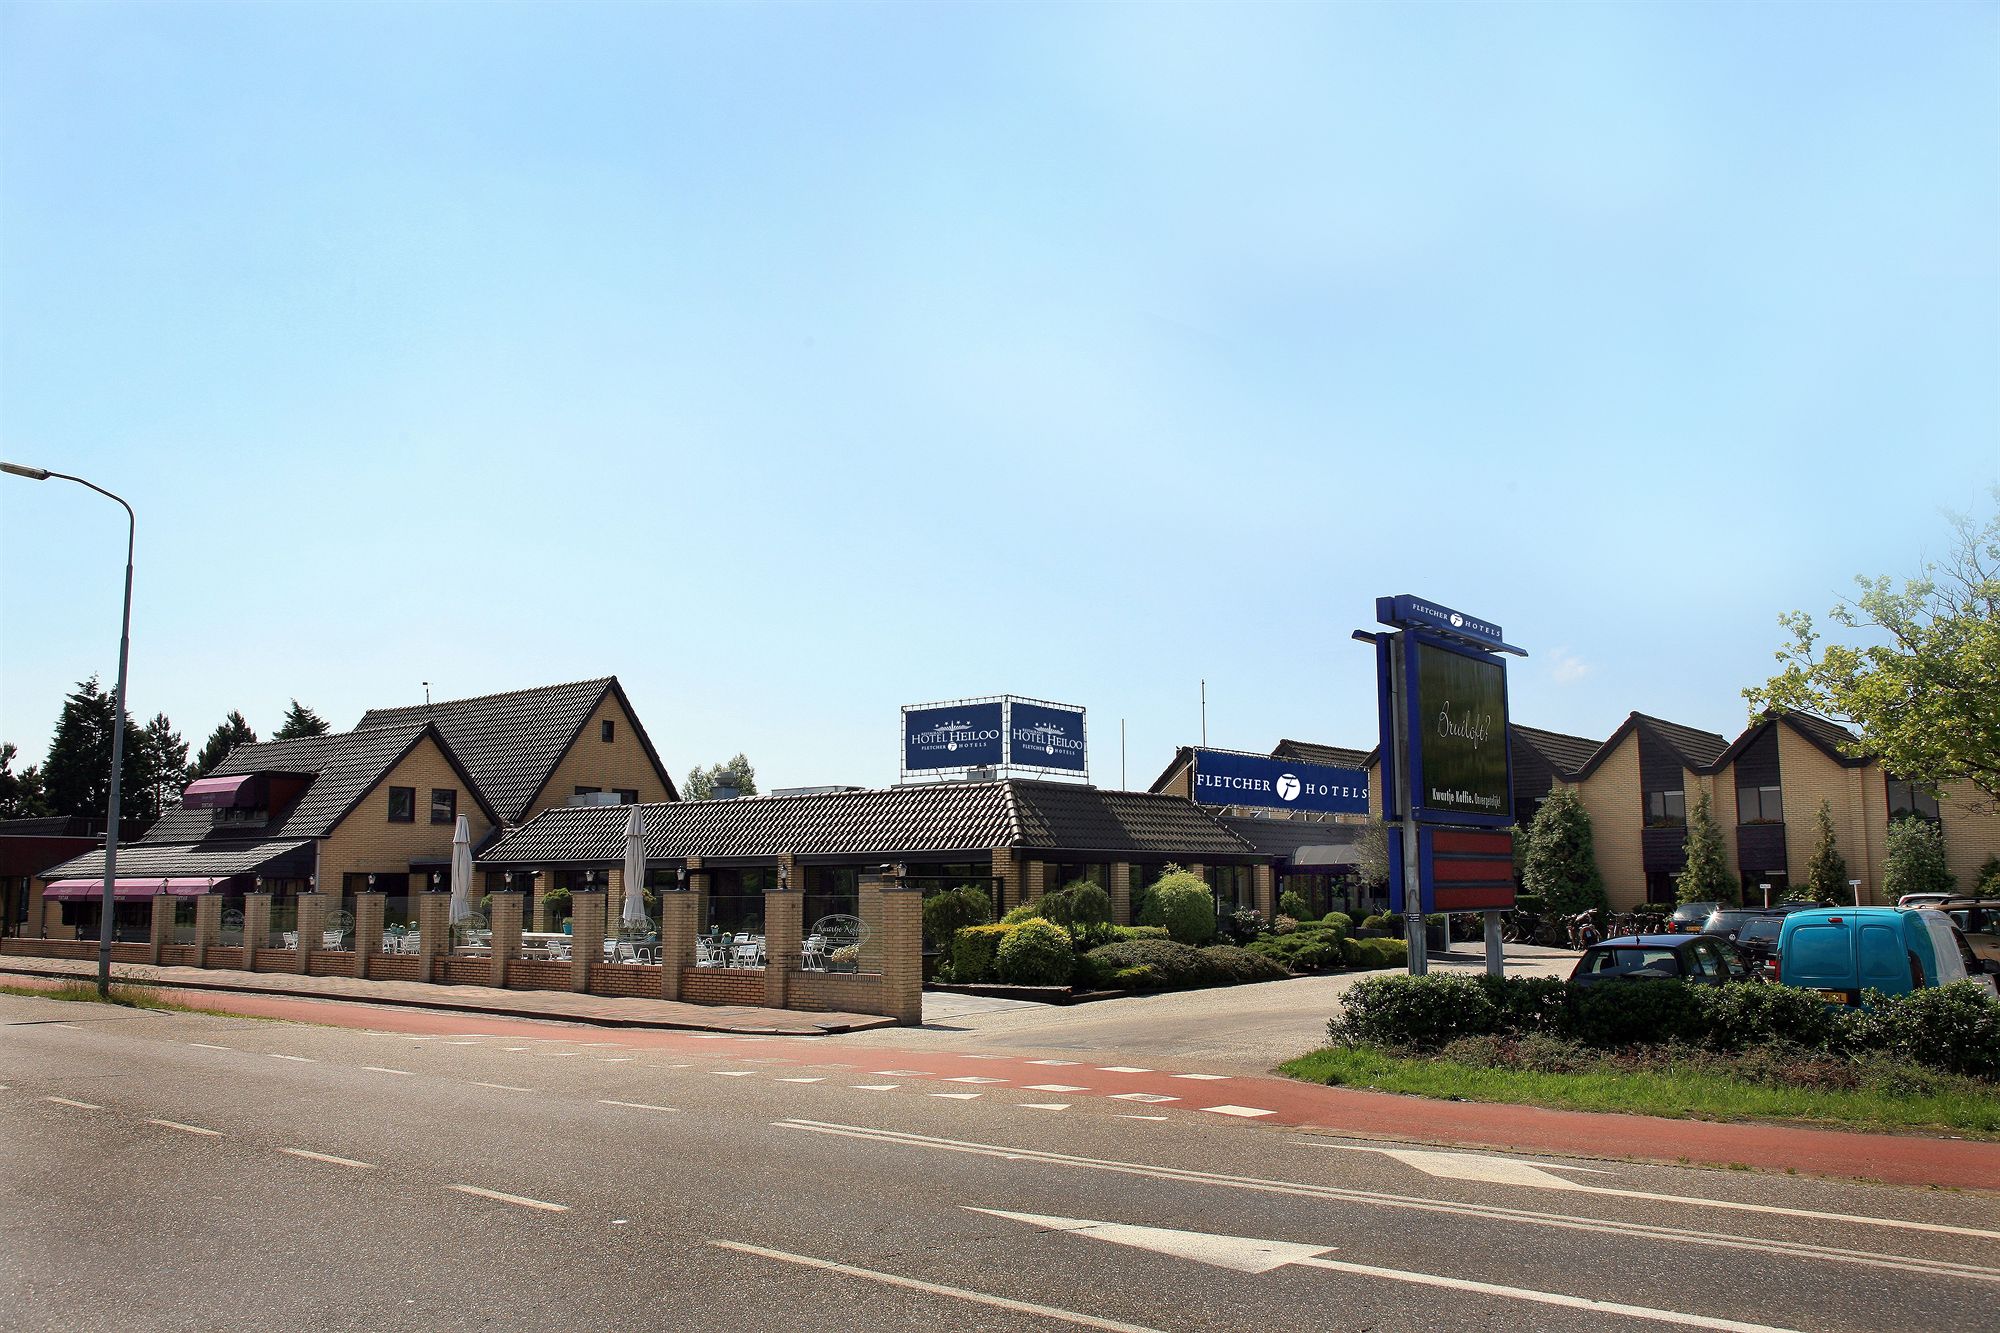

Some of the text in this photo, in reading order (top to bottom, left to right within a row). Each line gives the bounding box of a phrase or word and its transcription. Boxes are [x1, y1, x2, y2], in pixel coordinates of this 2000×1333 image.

[1412, 603, 1448, 620] FLETCHER
[1465, 620, 1501, 637] HOTELS
[911, 729, 1000, 745] HOTEL HEILOO
[1012, 728, 1083, 750] HOTEL HEILOO
[1022, 743, 1076, 756] FLETCHER HOTELS
[1196, 773, 1271, 792] FLETCHER
[1305, 783, 1368, 799] HOTELS
[1431, 787, 1455, 805] Kwartje
